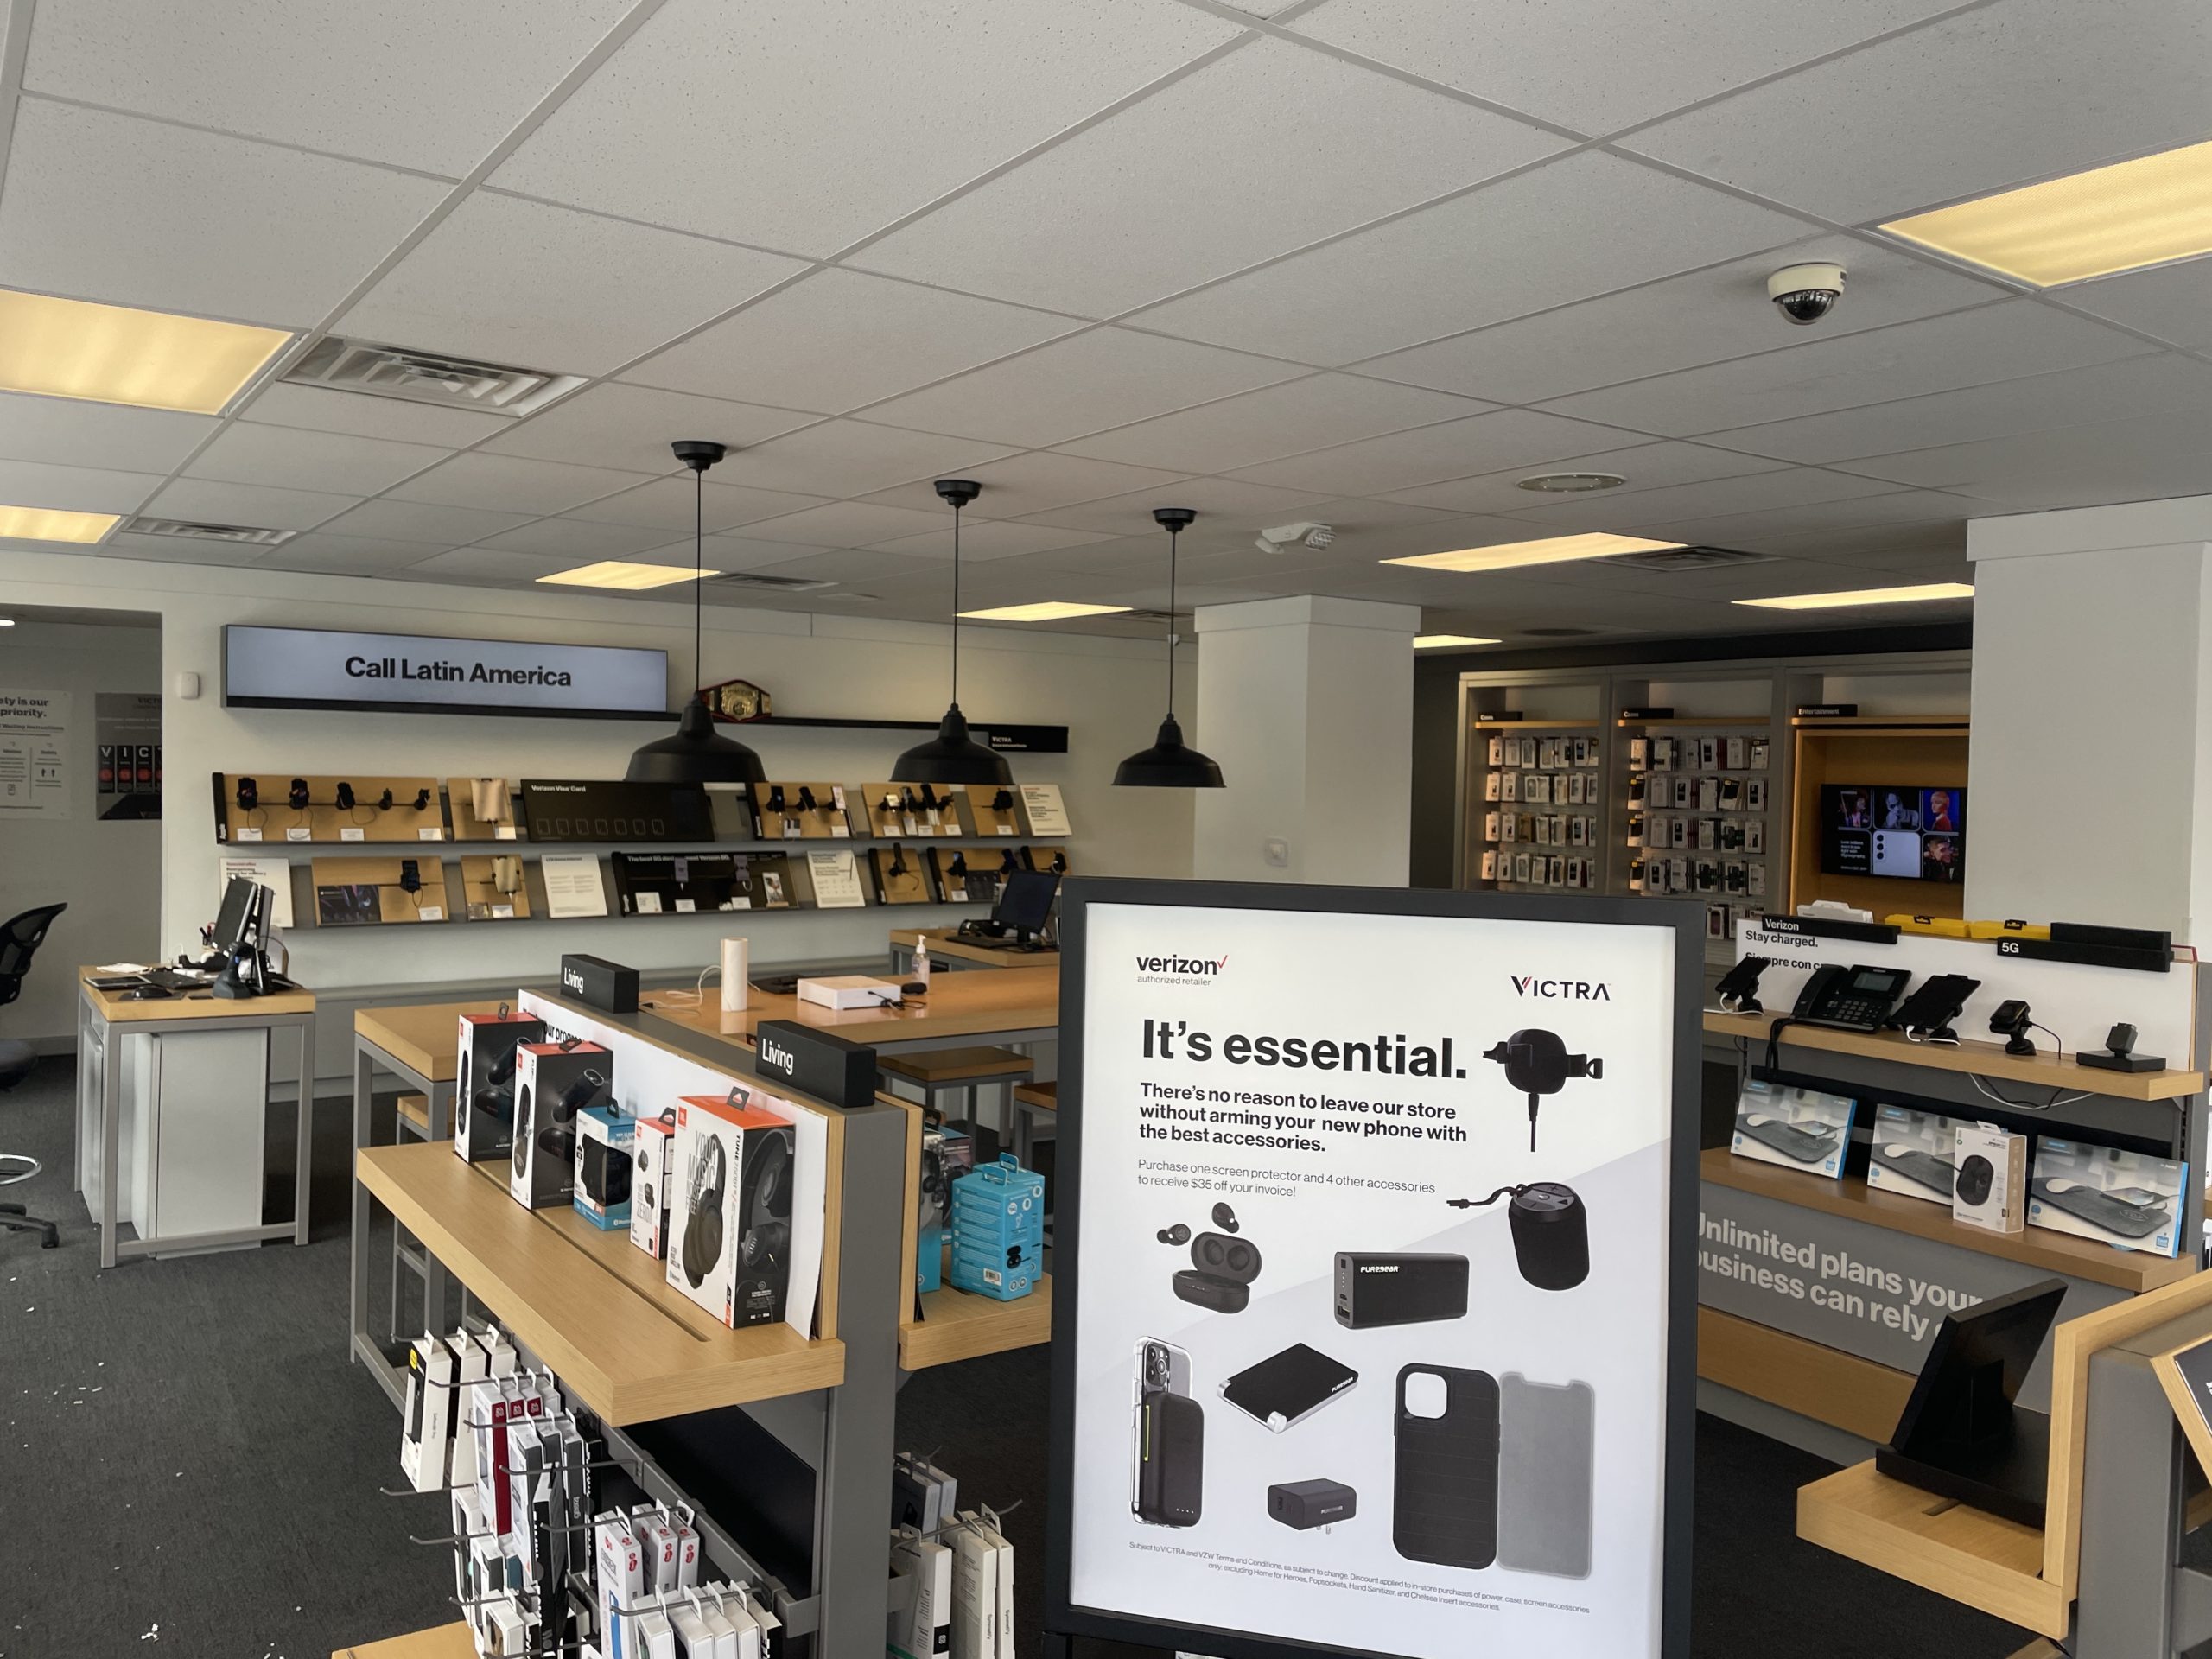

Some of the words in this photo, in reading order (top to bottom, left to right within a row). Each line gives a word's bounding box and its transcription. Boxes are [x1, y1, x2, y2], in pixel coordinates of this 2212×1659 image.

[346, 656, 395, 678] Call
[402, 658, 464, 682] Latin
[469, 663, 571, 686] America
[1745, 930, 1770, 944] Stay
[1771, 934, 1819, 948] charged.
[1764, 918, 1800, 931] Verizon
[2002, 942, 2018, 954] 5G
[1136, 954, 1217, 975] verizon
[1791, 959, 1811, 969] con
[563, 967, 584, 995] Living
[1137, 976, 1180, 984] authorized
[1182, 977, 1211, 986] retailer
[1510, 975, 1610, 1001] VICTRA
[762, 1038, 794, 1076] Living
[1143, 1020, 1212, 1061] It’s
[1224, 1034, 1467, 1078] essential.
[1141, 1083, 1205, 1101] There’s
[1209, 1089, 1230, 1103] no
[1234, 1091, 1295, 1108] reason
[1300, 1094, 1317, 1109] to
[1320, 1095, 1369, 1113] leave
[1372, 1103, 1404, 1116] our
[1407, 1102, 1456, 1119] store
[1140, 1104, 1206, 1122] without
[1209, 1109, 1271, 1129] arming
[1275, 1116, 1316, 1133] your
[1322, 1118, 1360, 1133] new
[1364, 1122, 1423, 1138] phone
[1427, 1125, 1467, 1142] with
[1140, 1124, 1167, 1139] the
[1171, 1128, 1209, 1143] best
[1212, 1133, 1325, 1152] accessories.
[1138, 1160, 1189, 1172] Purchase
[1191, 1165, 1211, 1174] one
[1212, 1166, 1249, 1177] screen
[1251, 1169, 1301, 1181] protector
[1303, 1173, 1324, 1184] and
[1326, 1175, 1333, 1185] 4
[1336, 1176, 1364, 1187] other
[1366, 1179, 1435, 1193] accessories
[1138, 1175, 1148, 1185] to
[1151, 1177, 1189, 1188] receive
[1191, 1178, 1212, 1190] $35
[1214, 1180, 1227, 1191] off
[1230, 1184, 1253, 1193] your
[1255, 1185, 1296, 1197] invoice!
[1821, 1252, 1902, 1294] plans
[1809, 1284, 1864, 1318] can
[1870, 1301, 1929, 1341] rely
[1129, 1541, 1153, 1551] Subject
[1160, 1546, 1185, 1555] VICTRA
[1216, 1554, 1235, 1562] Terms
[1293, 1566, 1315, 1574] subject
[1351, 1573, 1379, 1583] Discount
[1379, 1578, 1403, 1588] applied
[1412, 1583, 1437, 1592] in-store
[1438, 1587, 1472, 1598] purchases
[1548, 1603, 1590, 1614] accessories
[1224, 1565, 1253, 1575] excluding
[1254, 1569, 1273, 1578] Home
[1349, 1582, 1366, 1592] Hand
[1411, 1592, 1438, 1602] Chelsea
[1439, 1596, 1458, 1605] Insert
